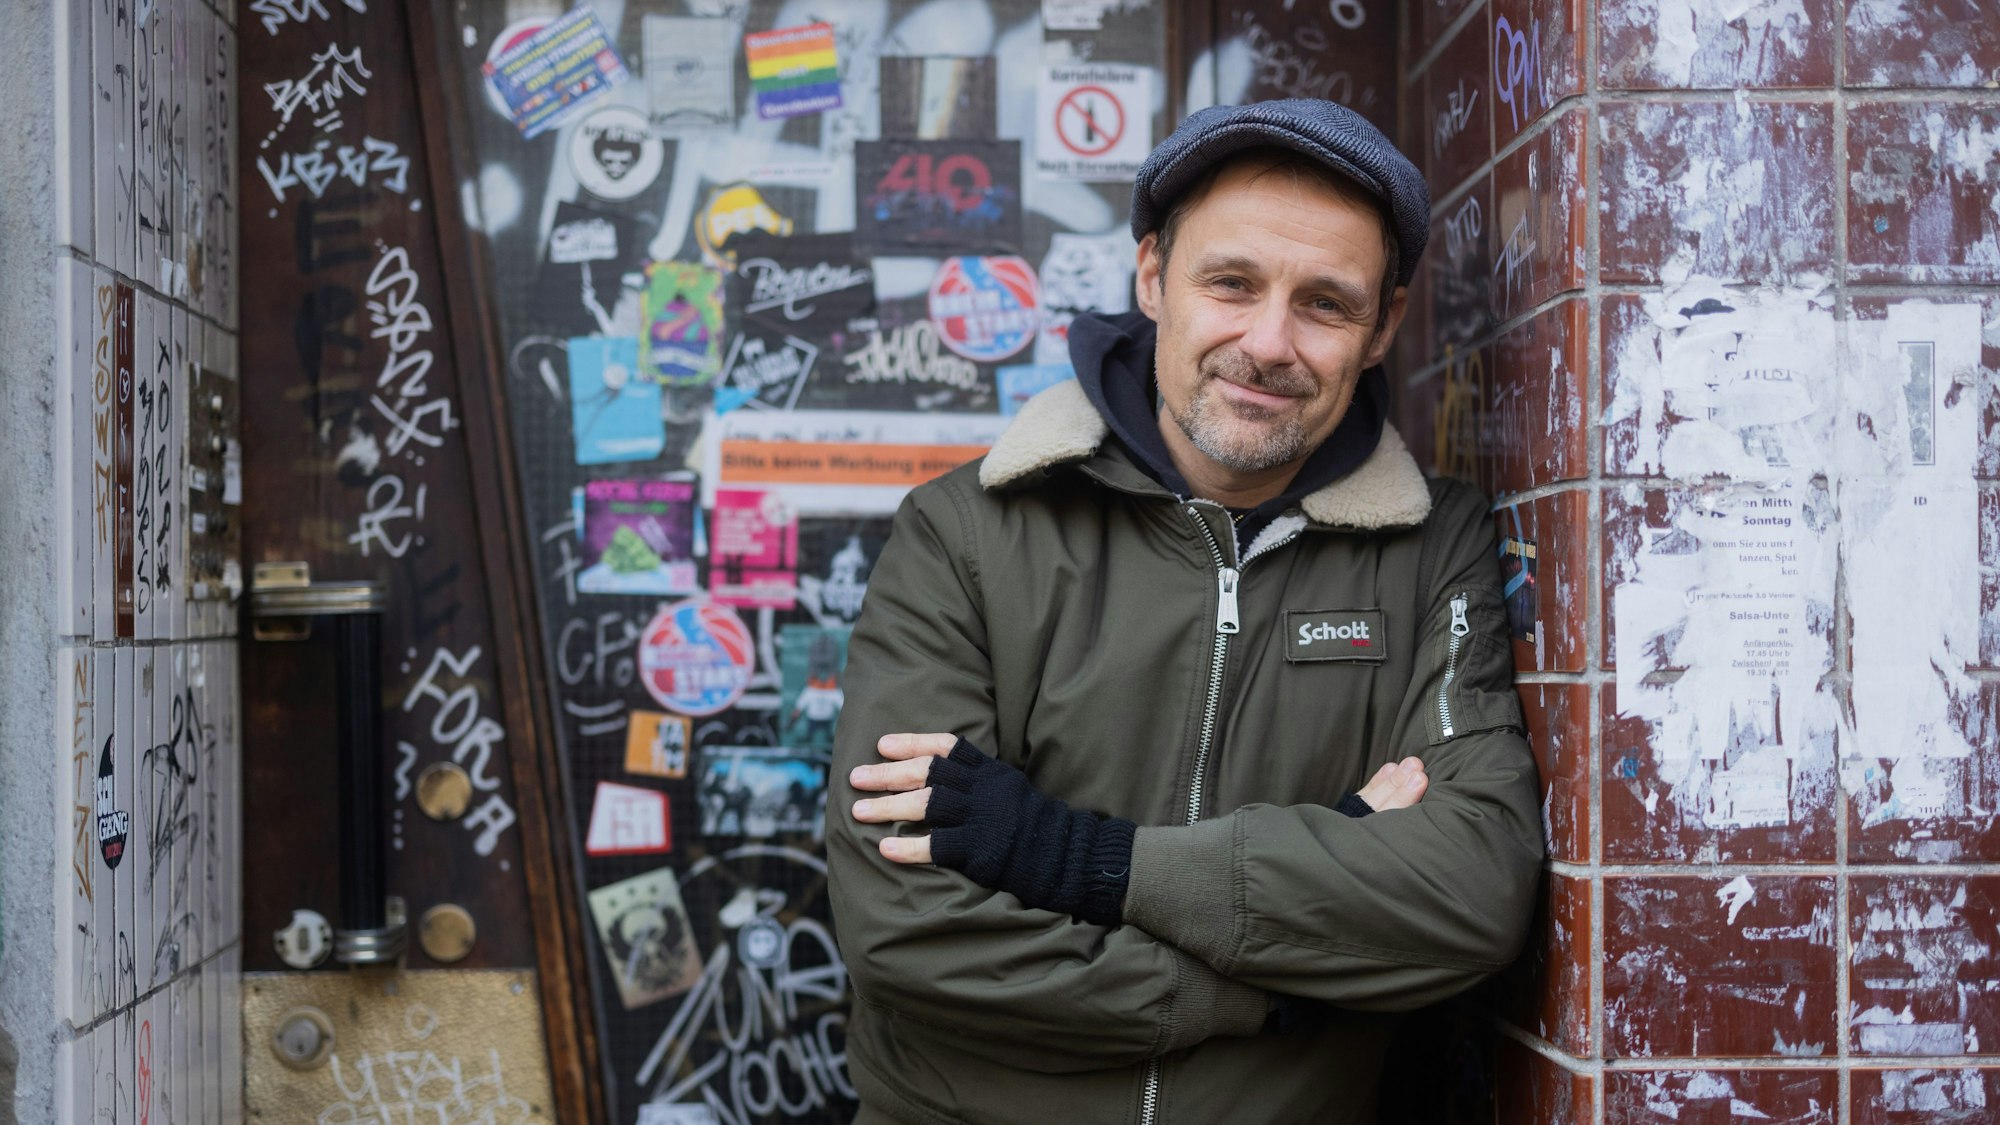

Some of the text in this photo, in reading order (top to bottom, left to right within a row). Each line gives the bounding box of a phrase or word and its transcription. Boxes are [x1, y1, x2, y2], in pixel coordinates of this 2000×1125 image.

[1742, 515, 1792, 528] Sonntag
[1739, 539, 1754, 549] Sie
[1756, 541, 1768, 549] zu
[1770, 541, 1787, 549] uns
[1729, 611, 1790, 620] Salsa-Unte
[1298, 621, 1370, 646] Schott
[1769, 649, 1783, 658] Uhr
[99, 811, 129, 842] GANG
